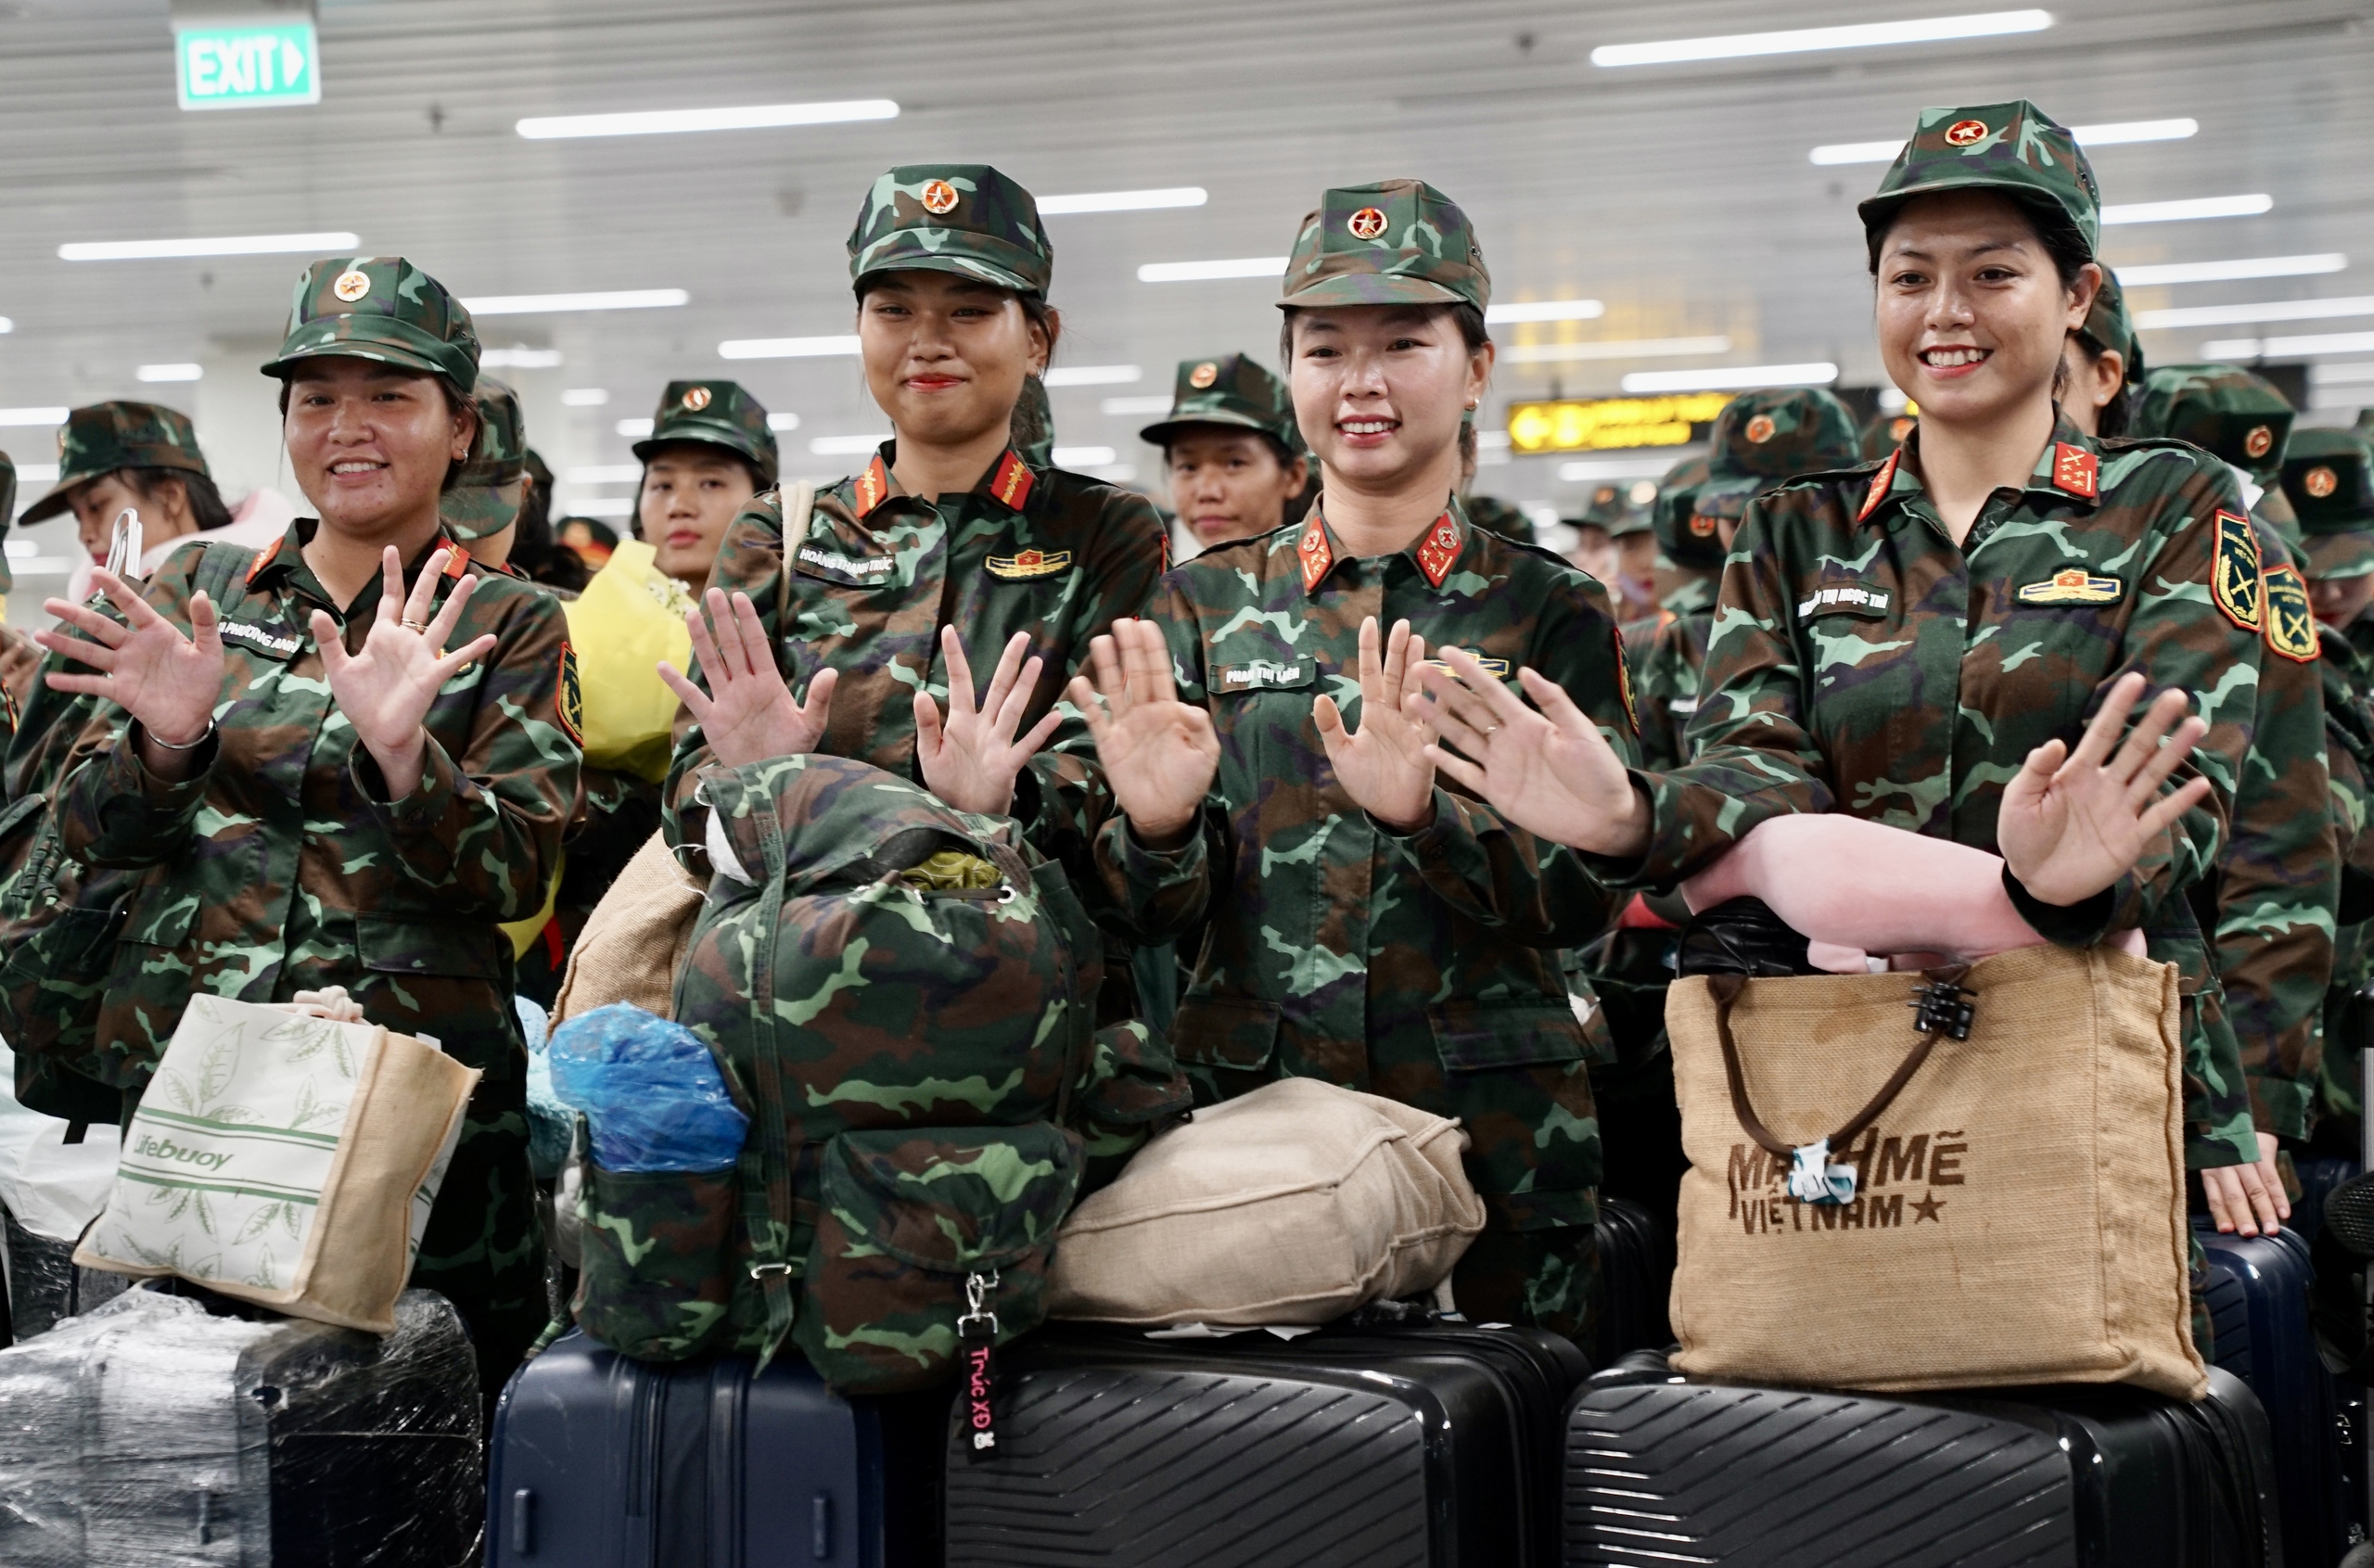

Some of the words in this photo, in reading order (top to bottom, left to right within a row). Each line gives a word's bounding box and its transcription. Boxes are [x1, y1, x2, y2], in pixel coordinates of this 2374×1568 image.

[188, 35, 278, 96] EXIT
[798, 548, 836, 569] HOÀNG
[836, 558, 869, 574] THANH
[869, 556, 894, 571] TRÚC
[270, 638, 300, 654] ANH
[1257, 667, 1275, 683] THỊ
[134, 1134, 235, 1171] Lifebuoy
[1741, 1184, 1804, 1234] VIỆT
[1811, 1193, 1904, 1231] NAM
[970, 1346, 991, 1397] Trúc
